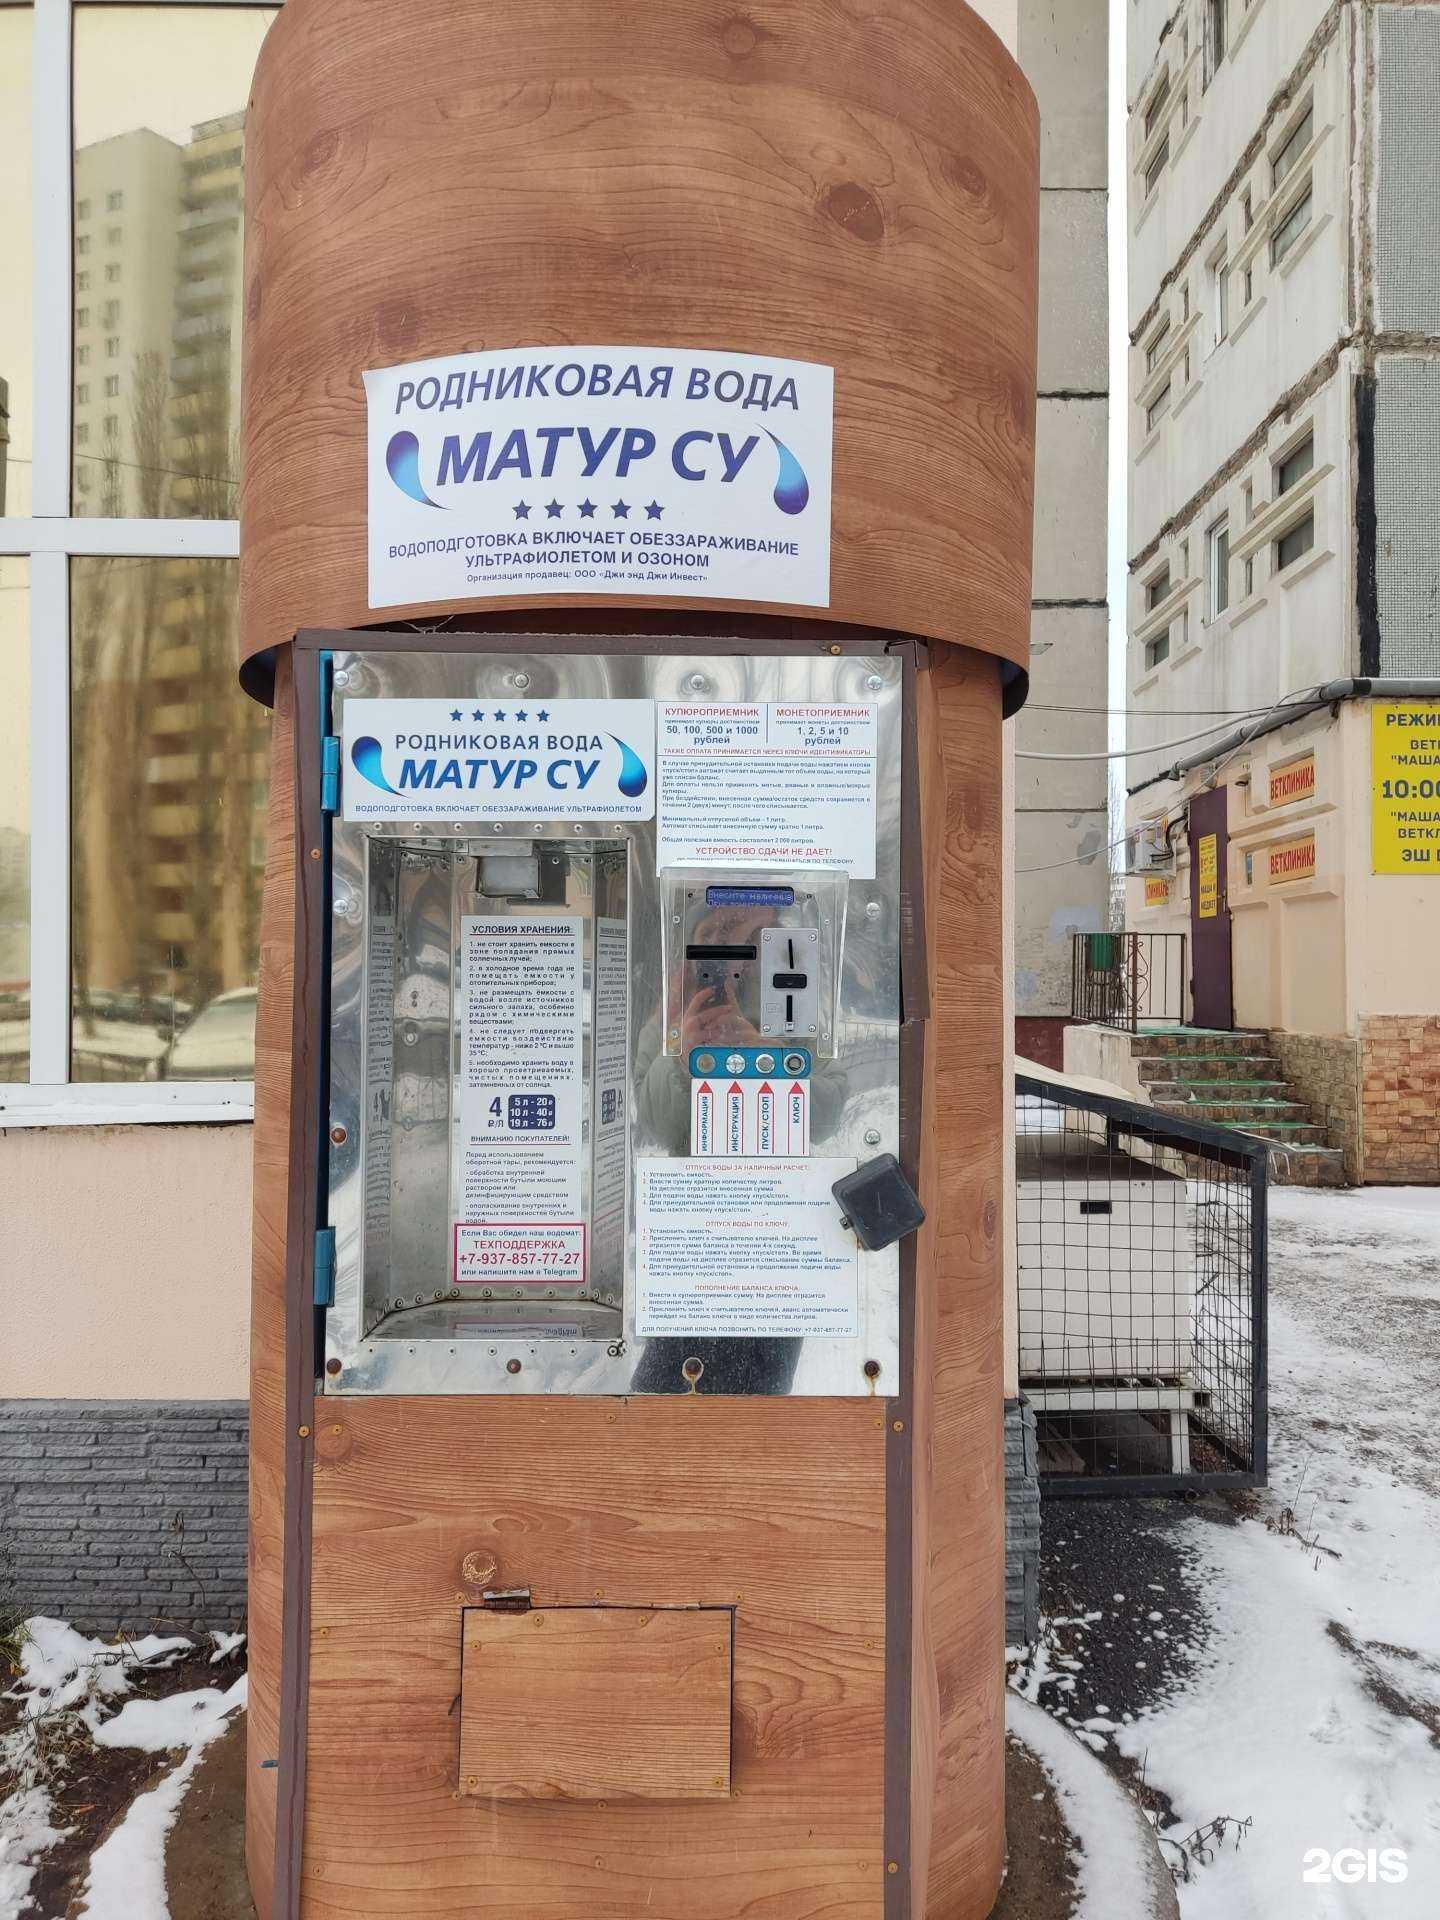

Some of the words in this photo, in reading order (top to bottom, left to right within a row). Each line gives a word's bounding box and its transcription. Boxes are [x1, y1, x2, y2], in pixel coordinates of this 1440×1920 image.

[395, 364, 673, 414] РОДНИКОВАЯ
[686, 369, 799, 411] ВОДА
[436, 427, 656, 486] МАТУР
[672, 430, 760, 482] СУ
[389, 532, 528, 558] ВОДОПОДГОТОВКА
[532, 530, 626, 546] ВКЛЮЧАЕТ
[630, 532, 799, 556] ОБЕЗЗАРАЖИВАНИЕ
[466, 550, 616, 568] УЛЬТРАФИОЛЕТОМ
[621, 551, 632, 564] И
[638, 552, 709, 567] ОЗОНОМ
[467, 572, 522, 583] Организация
[575, 570, 596, 578] ООО
[628, 572, 644, 580] энд
[647, 570, 667, 580] Джи
[665, 708, 759, 717] КУПЮРОПРИЕМНИК
[777, 709, 870, 717] МОНЕТОПРИЕМНИК
[1386, 714, 1440, 726] РЕЖИ
[707, 726, 723, 734] 500
[737, 726, 758, 734] 1000
[820, 727, 825, 735] 5
[839, 727, 848, 735] 10
[396, 735, 538, 751] РОДНИКОВАЯ
[548, 735, 602, 752] ВОДА
[694, 736, 730, 745] рублей
[805, 737, 840, 745] рублей
[1411, 740, 1440, 750] ВЕТ
[400, 759, 538, 789] МАТУР
[547, 759, 600, 789] СУ
[1271, 765, 1314, 800] ВЕТКЛИНИКА
[356, 805, 433, 813] ВОДОПОДГОТОВКА
[436, 805, 480, 813] ВКЛЮЧАЕТ
[482, 805, 564, 813] ОБЕЗЗАРАЖИВАНИЕ
[567, 805, 641, 813] УЛЬТРАФИОЛЕТОМ
[696, 847, 755, 856] УСТРОЙСТВО
[758, 848, 788, 856] СДАЧИ
[1402, 850, 1430, 861] ЭШ
[1271, 844, 1315, 875] ВЕТКЛИНИКА
[490, 1097, 502, 1116] 4
[474, 1241, 565, 1250] ТЕХПОДДЕРЖКА
[460, 1253, 580, 1265] +7-937-857-77-27
[544, 1268, 578, 1277] Telegram
